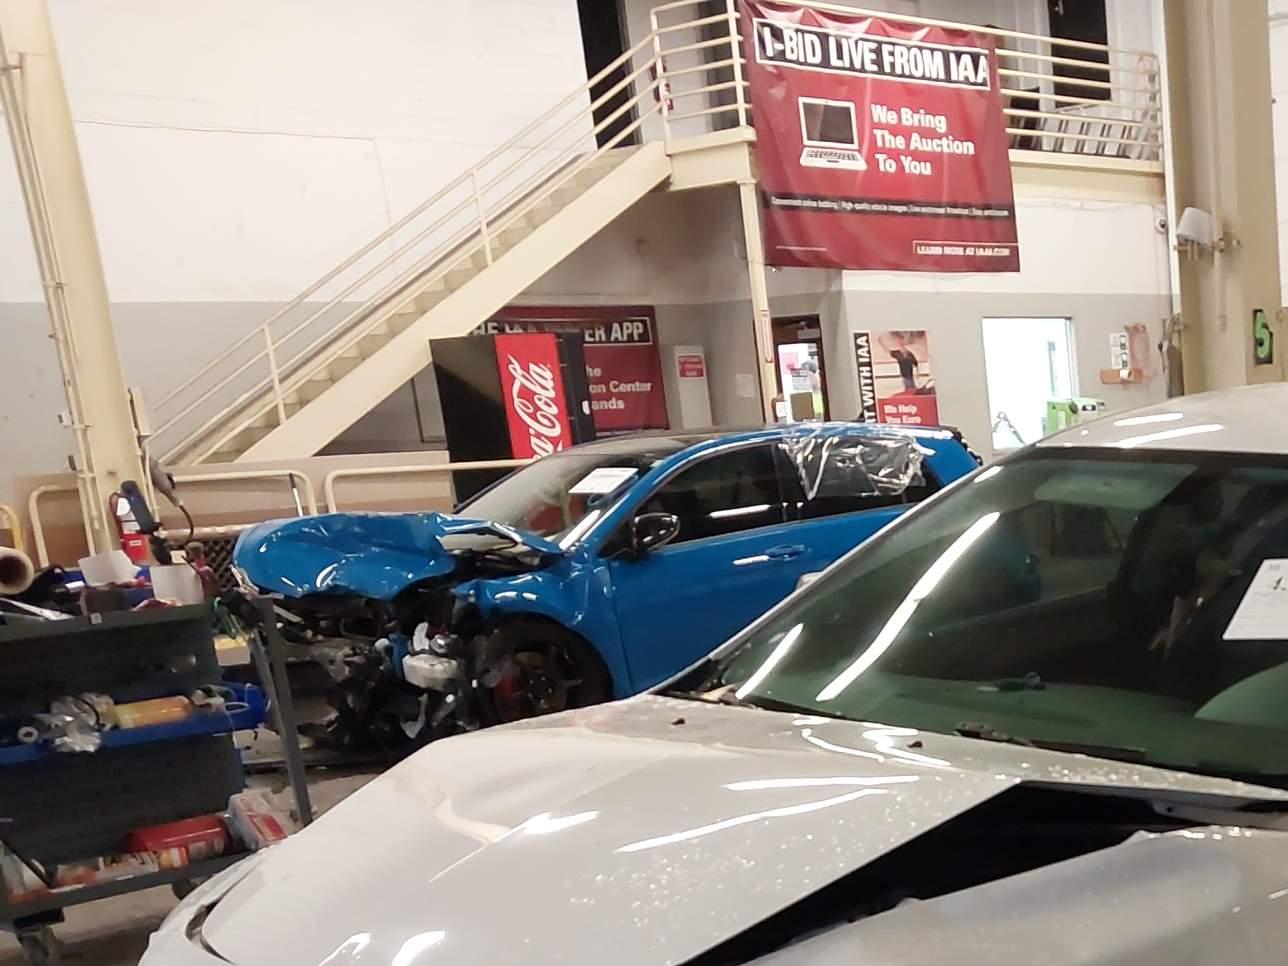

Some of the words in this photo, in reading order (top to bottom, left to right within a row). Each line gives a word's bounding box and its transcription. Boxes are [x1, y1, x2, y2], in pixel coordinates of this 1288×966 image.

[762, 27, 822, 64] I-BID
[829, 36, 878, 72] LIVE
[881, 43, 945, 81] FROM
[950, 52, 988, 83] IAA
[871, 104, 898, 124] We
[901, 108, 947, 133] Bring
[874, 130, 905, 149] The
[910, 133, 975, 155] Auction
[875, 154, 896, 173] To
[902, 158, 932, 176] You
[611, 321, 644, 342] APP
[856, 335, 871, 363] IAA
[609, 380, 652, 393] Center
[859, 366, 875, 407] WITH
